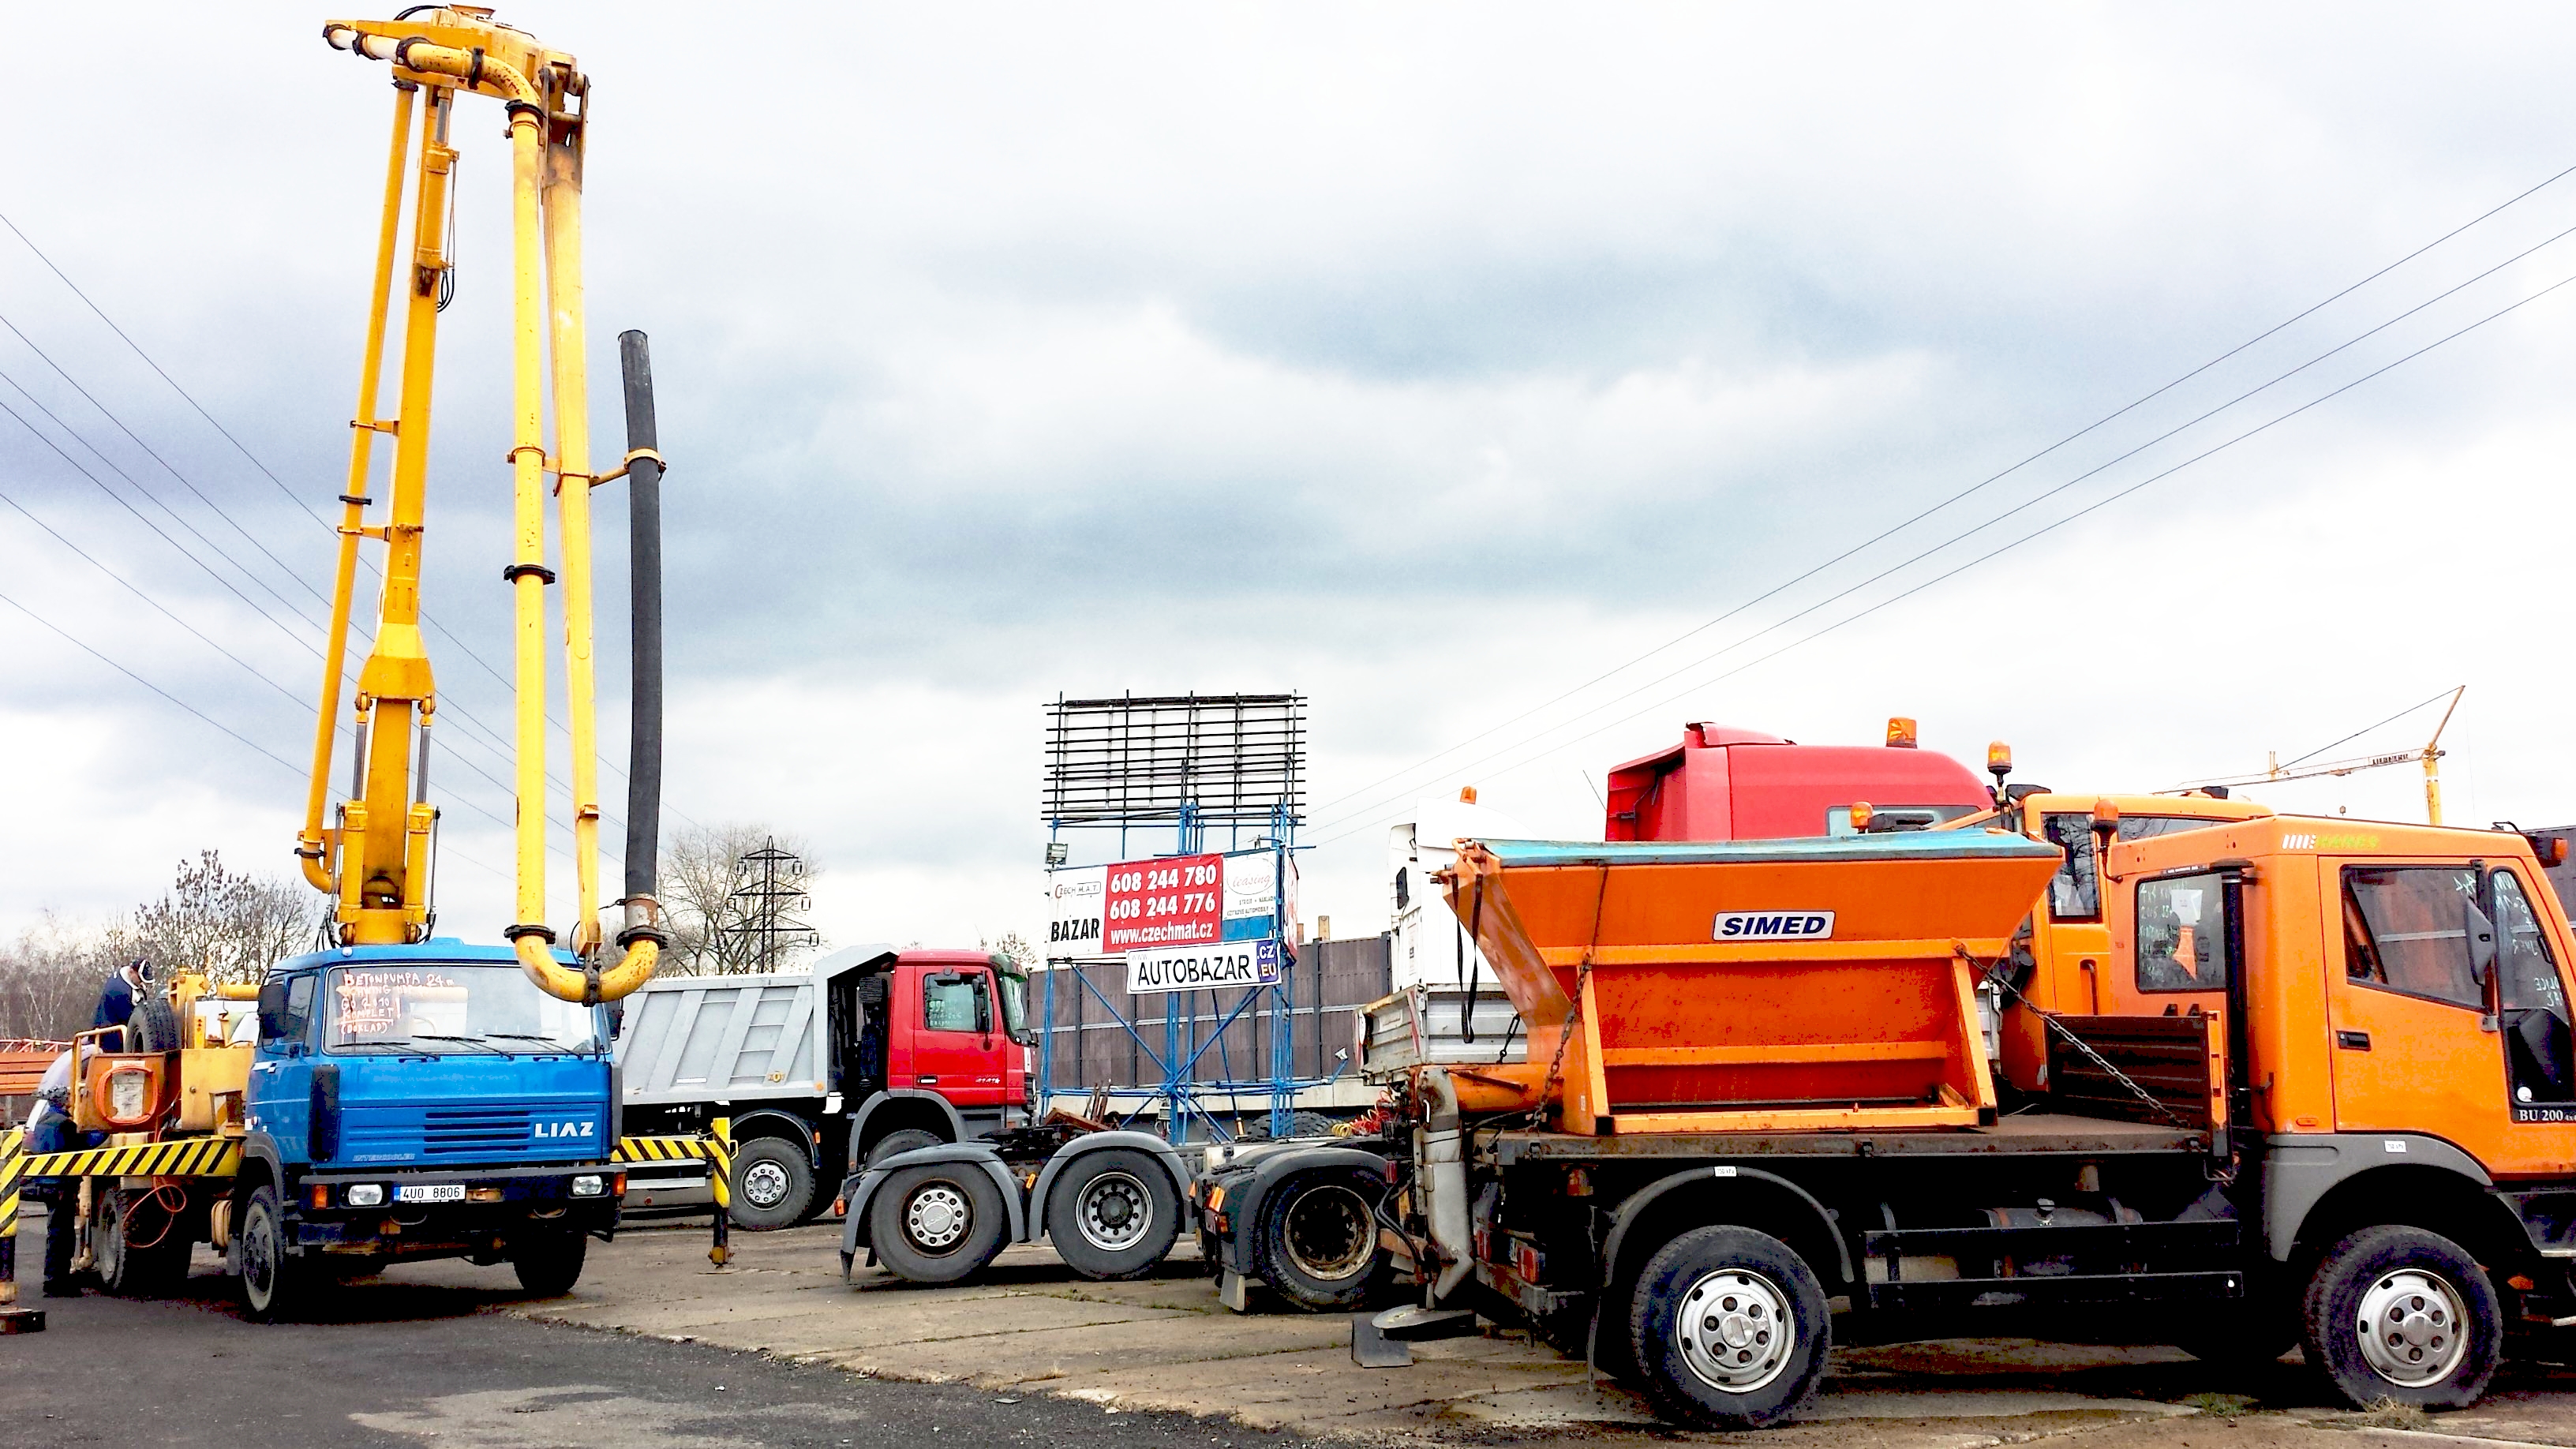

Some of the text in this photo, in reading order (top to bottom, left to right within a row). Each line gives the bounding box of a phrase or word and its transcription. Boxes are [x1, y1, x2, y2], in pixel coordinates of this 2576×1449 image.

[1110, 864, 1216, 893] 608 244 780
[1110, 892, 1216, 920] 608 244 776
[1051, 918, 1100, 942] BAZAR
[1110, 919, 1214, 945] www.czechmat.cz
[1721, 916, 1826, 936] SIMED
[426, 973, 444, 987] 24
[1138, 954, 1252, 987] AUTOBAZAR
[2519, 1109, 2538, 1121] BU
[2541, 1109, 2564, 1121] 200
[534, 1121, 594, 1138] LIAZ
[432, 1186, 460, 1198] 8806
